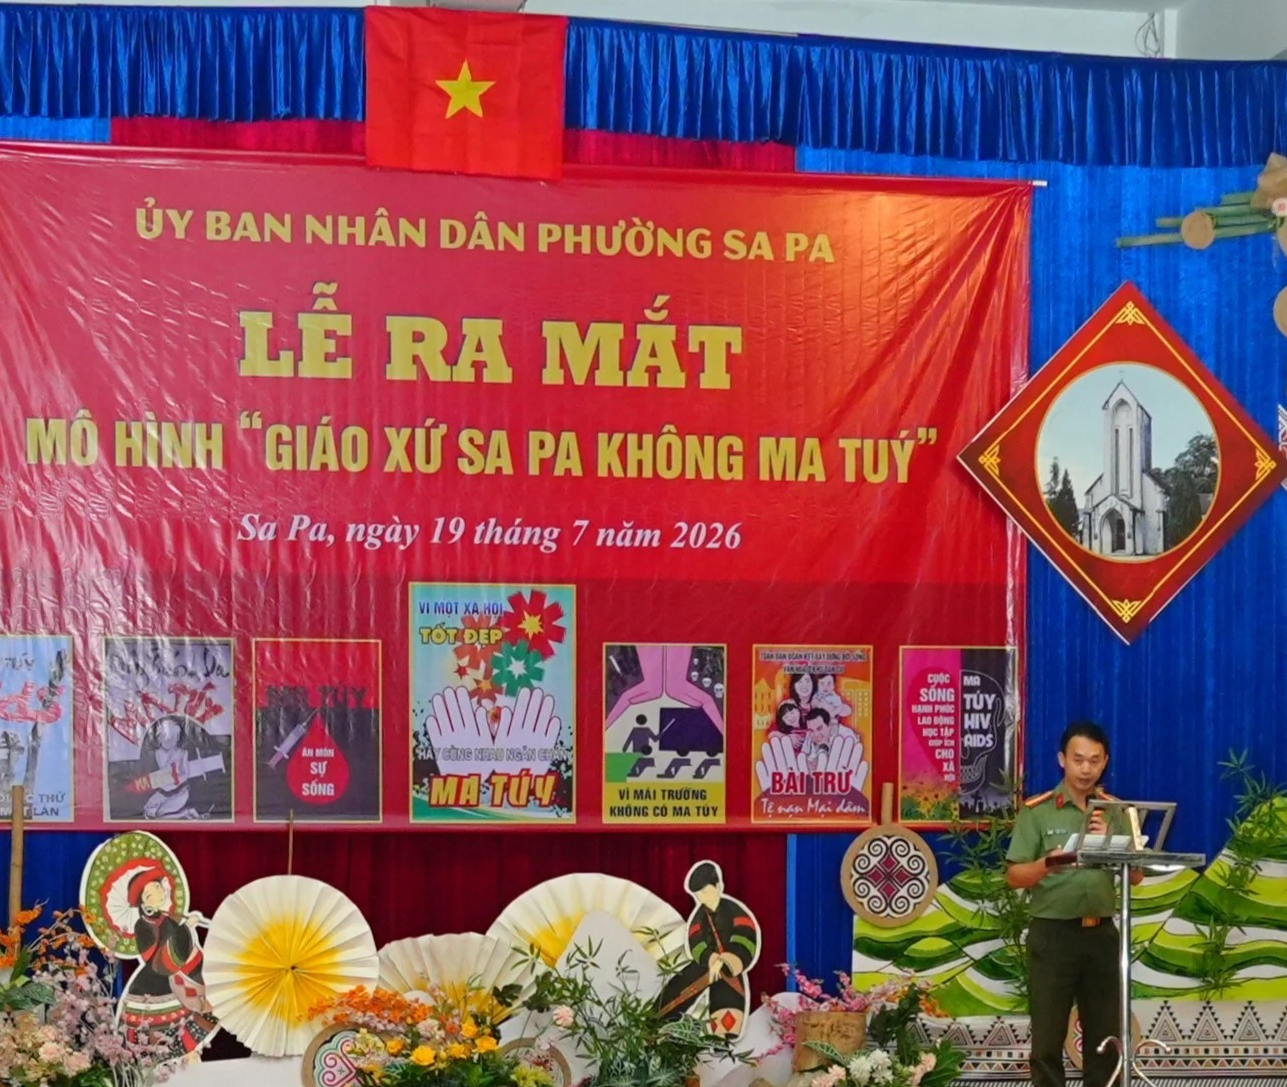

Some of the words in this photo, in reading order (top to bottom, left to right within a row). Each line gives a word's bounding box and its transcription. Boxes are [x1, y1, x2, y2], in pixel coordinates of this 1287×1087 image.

[135, 197, 193, 240] ỦY
[205, 210, 292, 244] BAN
[305, 206, 427, 249] NHÂN
[439, 210, 525, 252] DÂN
[538, 216, 712, 259] PHƯỜNG
[723, 228, 774, 261] SA
[785, 231, 835, 263] PA
[238, 281, 354, 380] LỄ
[385, 314, 513, 385] RA
[541, 294, 743, 390] MẮT
[25, 408, 100, 467] MÔ
[114, 410, 224, 470] HÌNH
[383, 417, 448, 474] XỨ
[457, 428, 513, 476] SA
[528, 429, 583, 477] PA
[597, 424, 745, 481] KHÔNG
[758, 435, 826, 483] MA
[237, 512, 280, 544] Sa
[288, 513, 336, 550] Pa,
[345, 516, 421, 553] ngày
[430, 517, 465, 546] 19
[472, 517, 561, 553] tháng
[572, 520, 590, 547] 7
[596, 521, 661, 548] năm
[670, 521, 743, 549] 2026
[419, 622, 459, 645] TỐT
[963, 675, 981, 686] MA
[919, 683, 955, 702] SỐNG
[963, 690, 996, 710] TÚY
[963, 713, 992, 730] HIV
[963, 734, 993, 748] AIDS
[935, 748, 954, 759] CHO
[301, 779, 335, 797] SỐNG
[429, 773, 482, 808] MA
[489, 768, 561, 808] TÚY
[770, 766, 806, 795] BÀI
[812, 765, 854, 795] TRỪ
